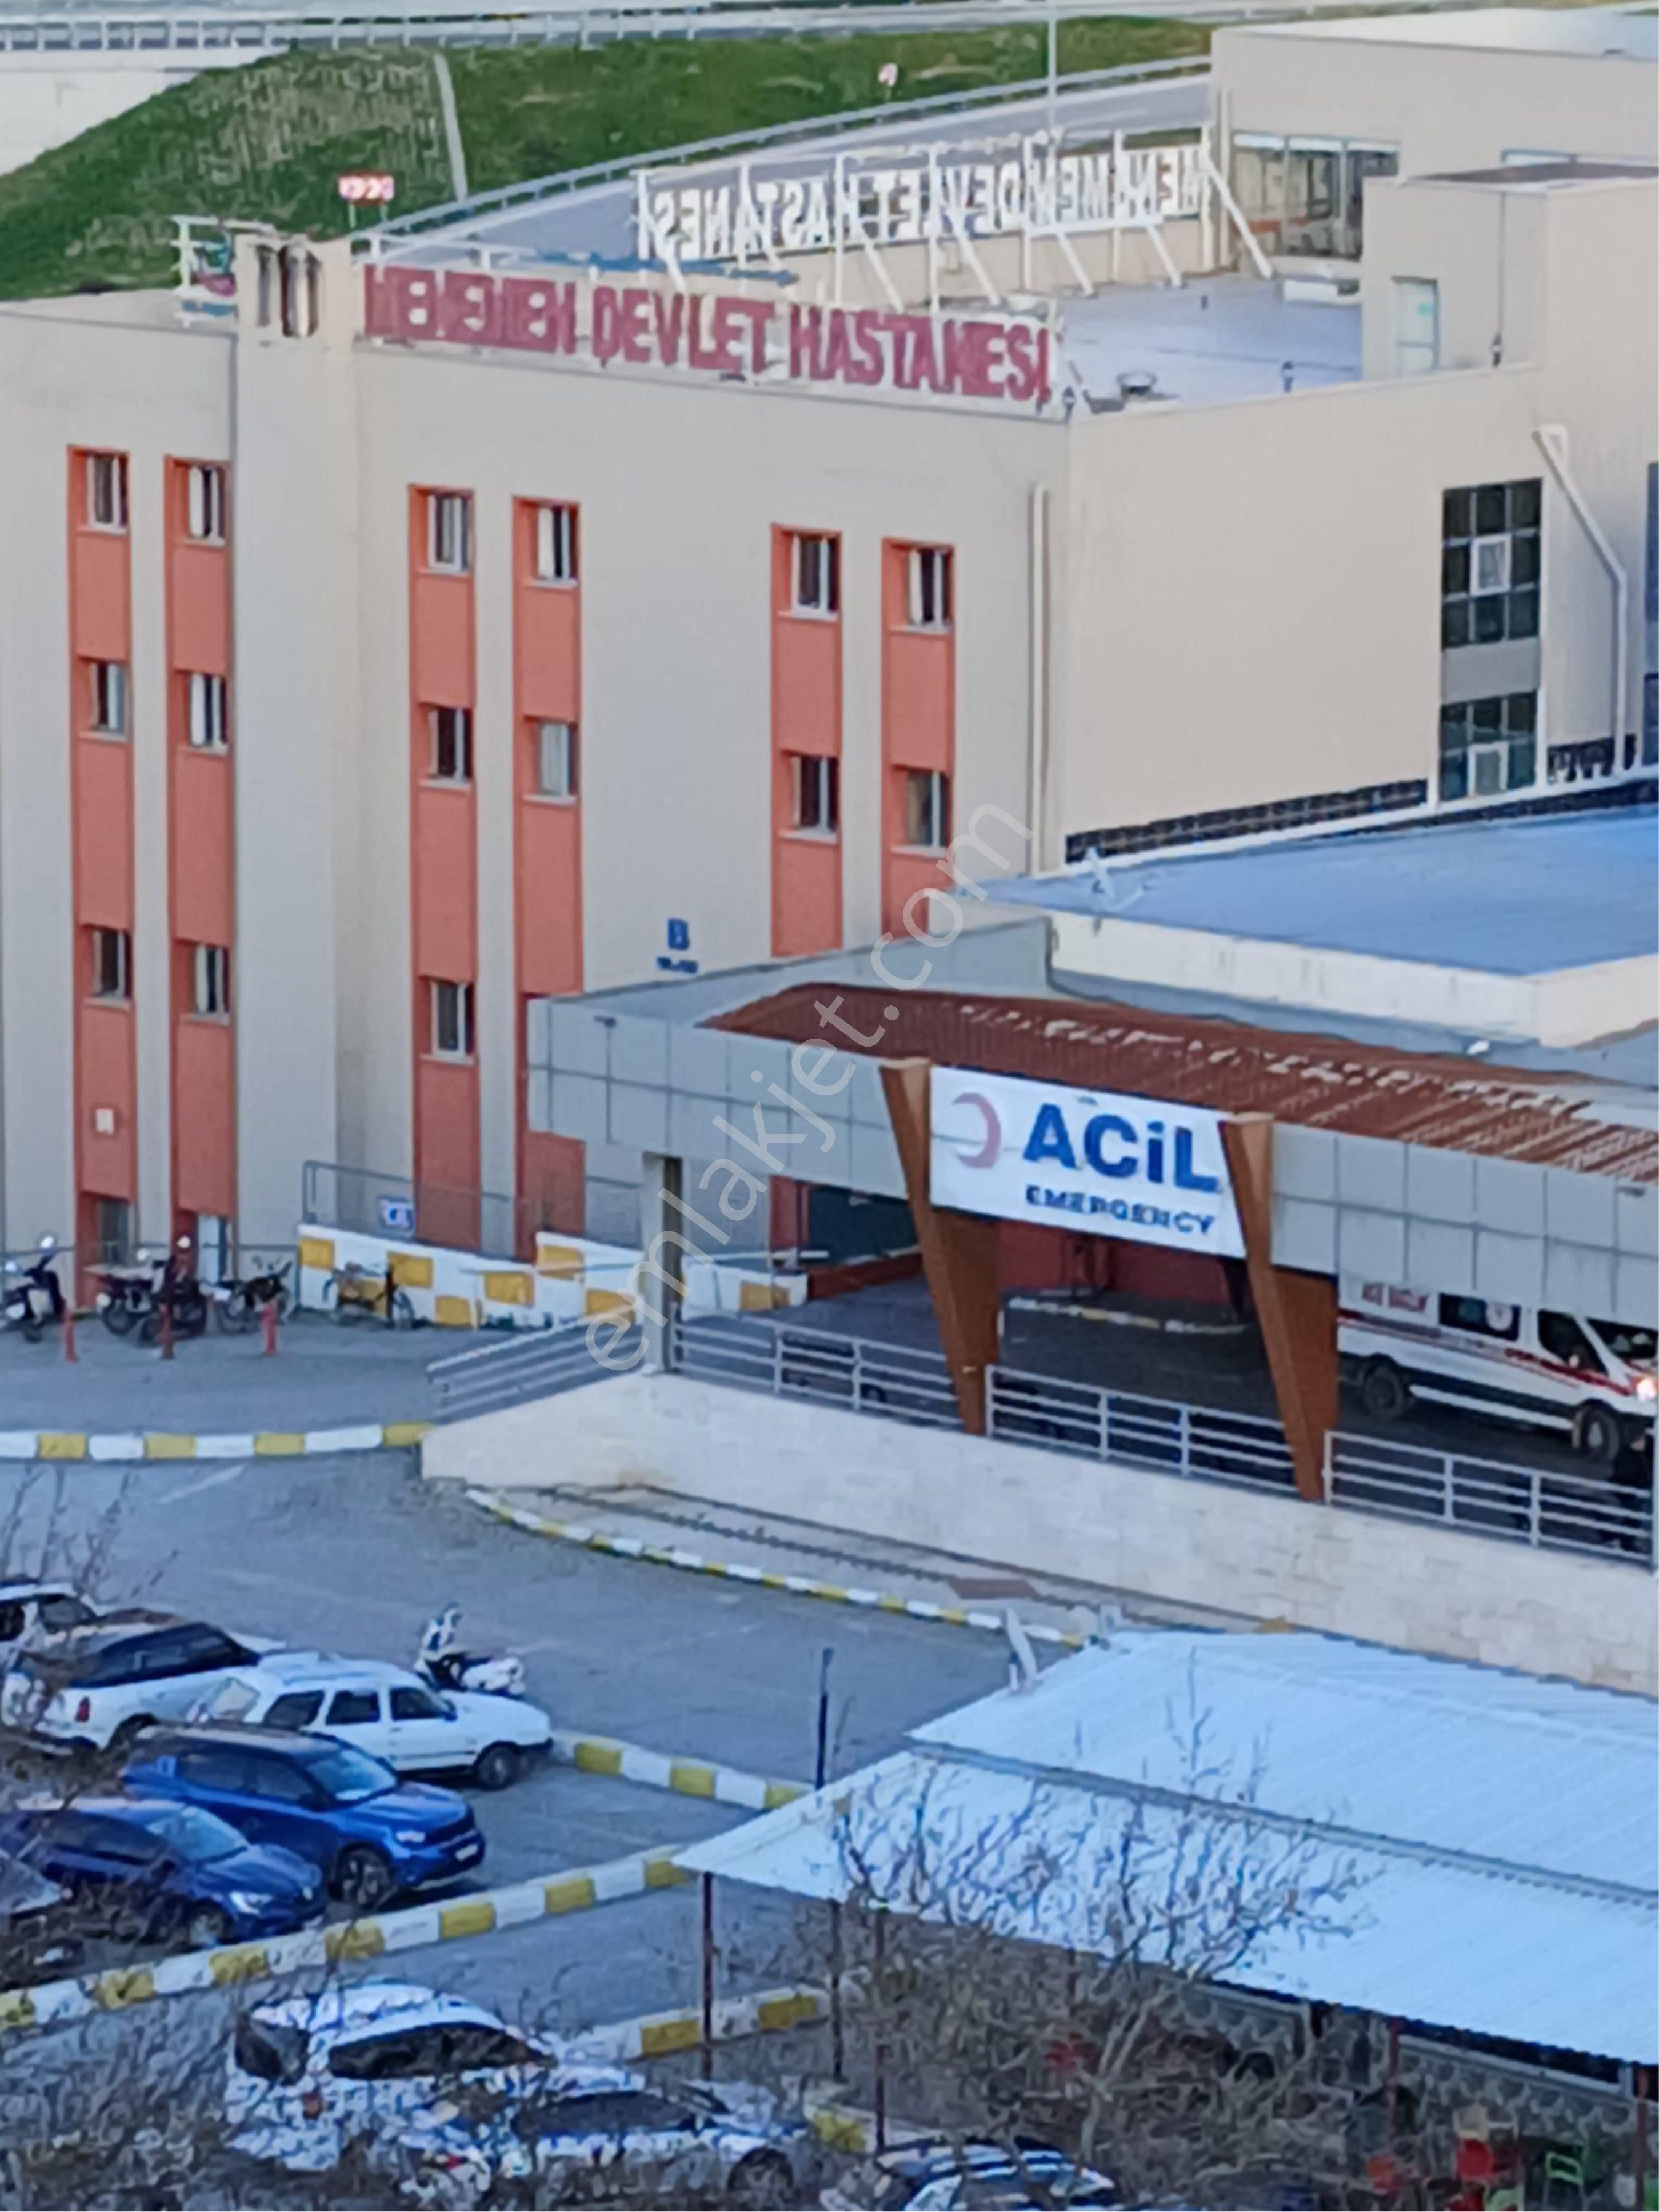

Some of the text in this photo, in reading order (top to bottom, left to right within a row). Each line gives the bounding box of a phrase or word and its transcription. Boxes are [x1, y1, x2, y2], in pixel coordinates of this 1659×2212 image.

[591, 285, 777, 375] DEVLET
[668, 918, 689, 951] B
[1025, 1184, 1215, 1234] EMERGENCY
